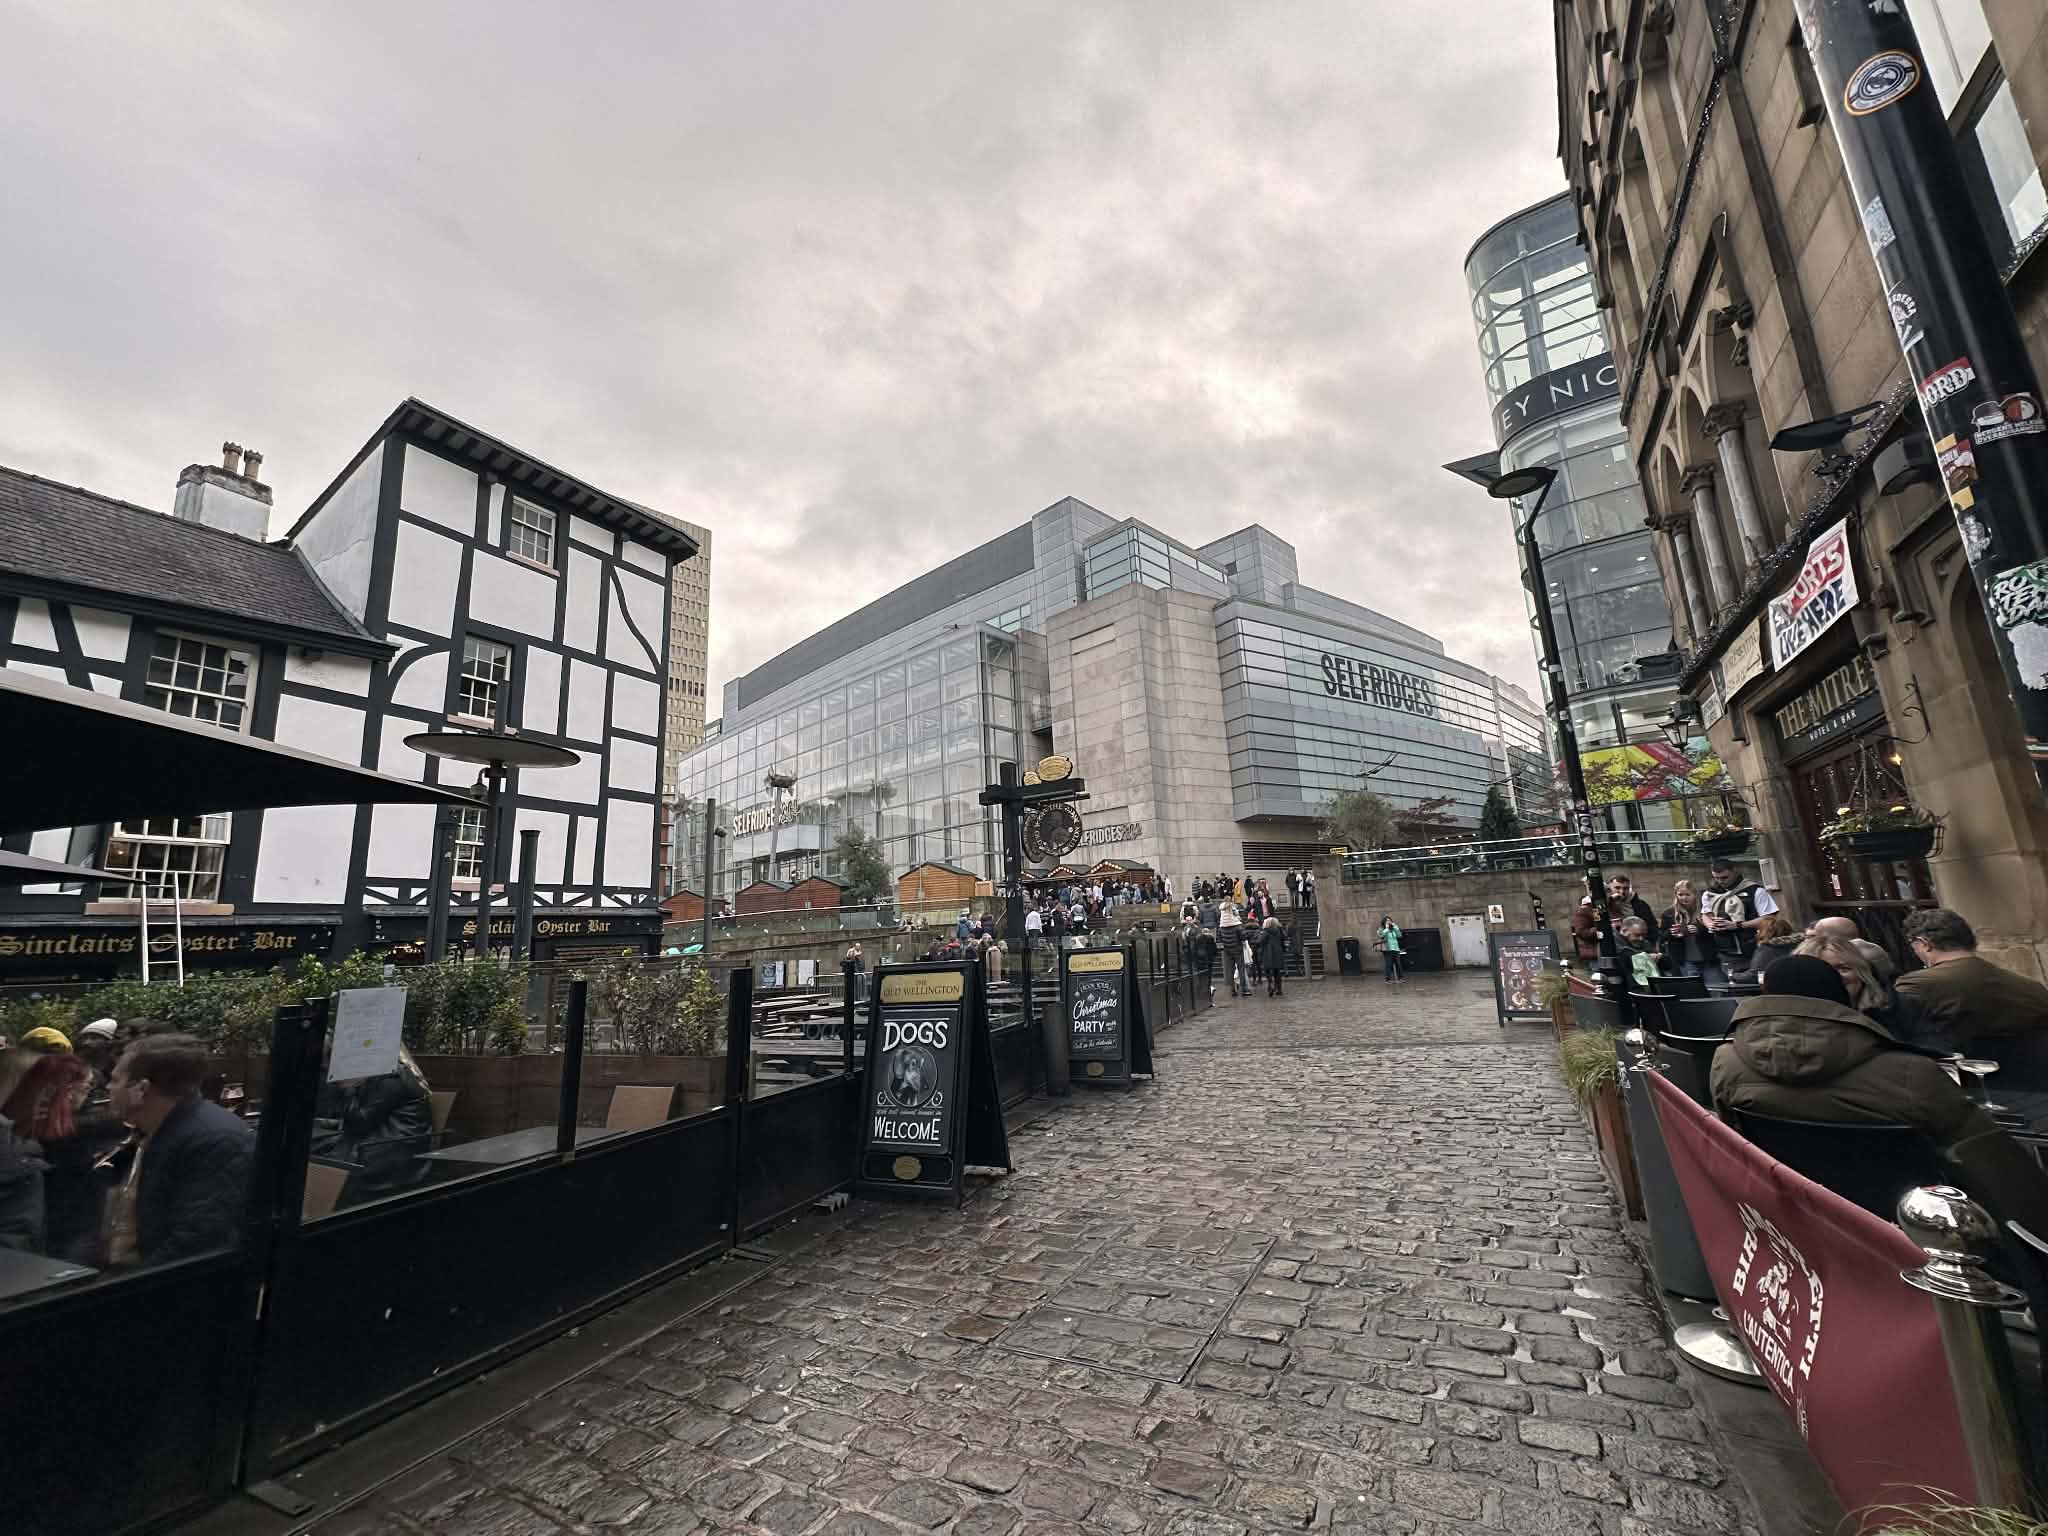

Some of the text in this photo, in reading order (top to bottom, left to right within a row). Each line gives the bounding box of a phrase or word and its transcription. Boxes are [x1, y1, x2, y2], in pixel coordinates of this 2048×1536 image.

[1321, 654, 1434, 717] SELFRIDGES
[1776, 695, 1808, 740] THE
[1807, 655, 1869, 717] MITRE
[733, 805, 778, 837] SELFRIDGE
[537, 919, 582, 937] Oyster
[587, 919, 611, 934] Bar
[0, 933, 136, 956] Sinclairs
[251, 931, 297, 951] Bar
[903, 984, 960, 997] WELLINGTON
[1072, 996, 1118, 1020] Christmas
[882, 1020, 949, 1053] DOGS
[1073, 1020, 1104, 1033] PARTY
[1743, 1309, 1795, 1395] L'AUTENTICA
